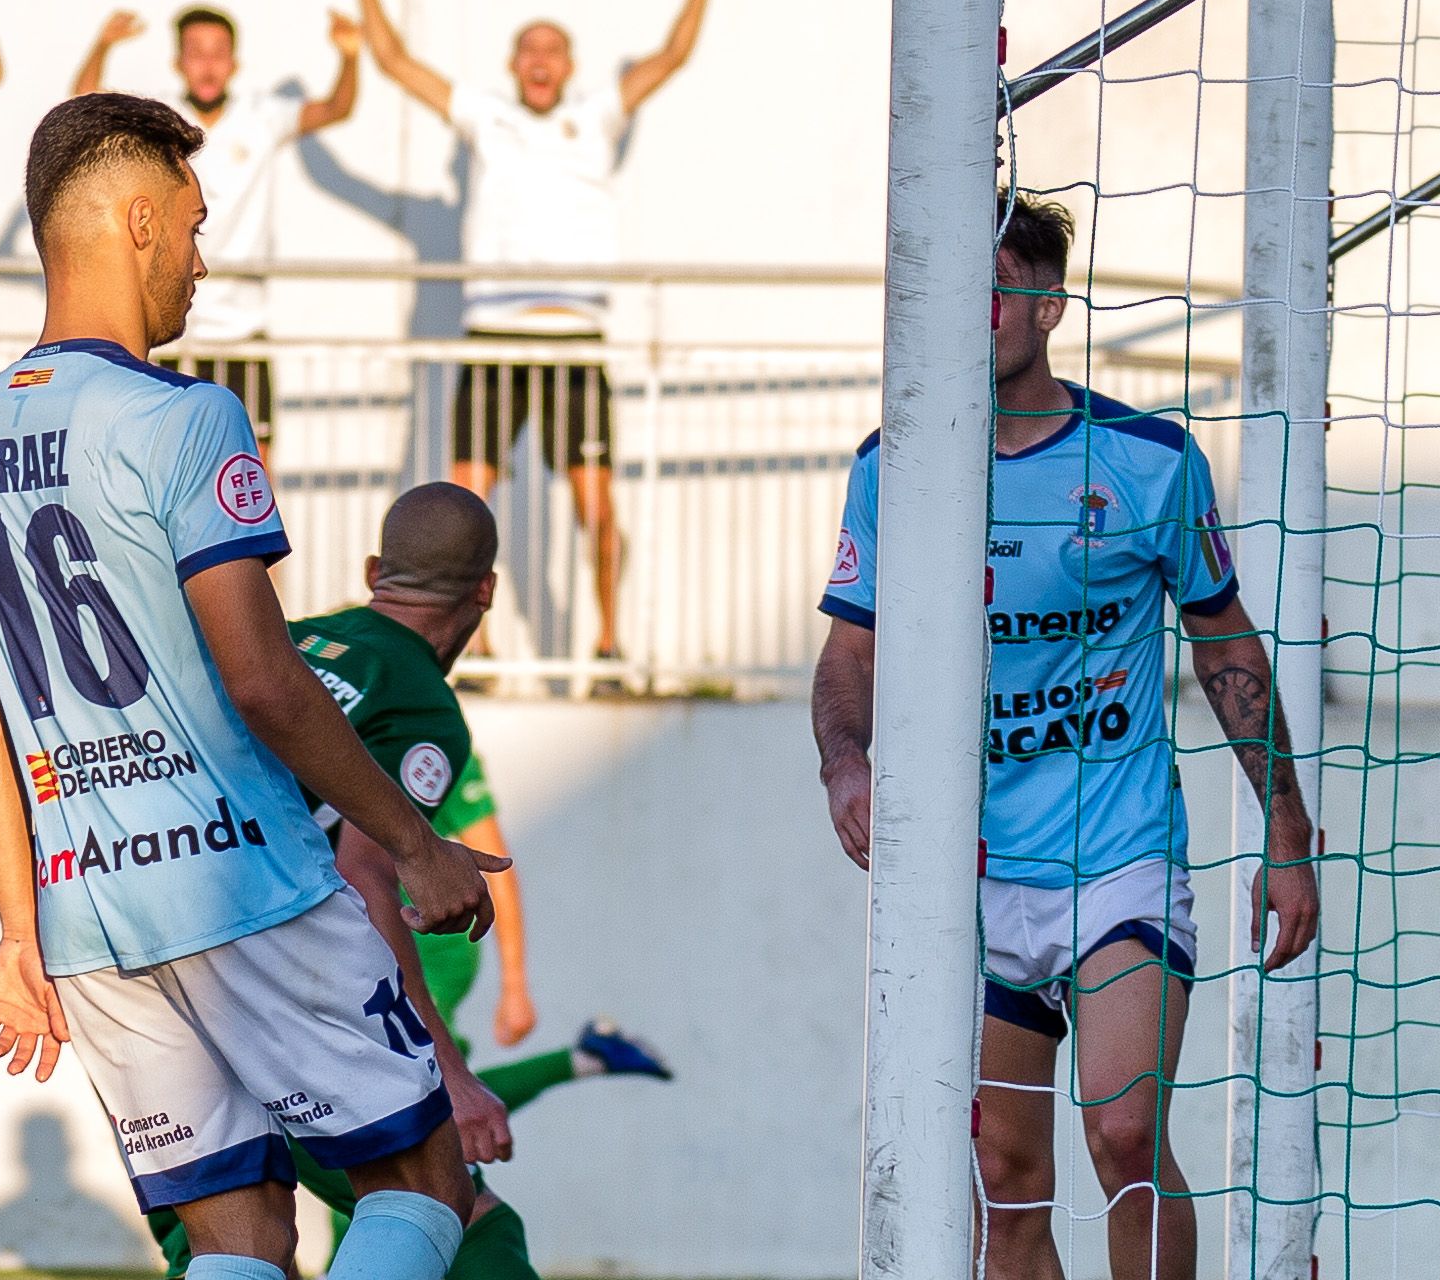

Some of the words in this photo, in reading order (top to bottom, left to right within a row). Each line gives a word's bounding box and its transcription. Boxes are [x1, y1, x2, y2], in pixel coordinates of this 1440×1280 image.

[230, 470, 258, 488] RF
[235, 489, 263, 508] EF
[988, 601, 1121, 644] arena
[992, 677, 1093, 719] LEJOS
[53, 729, 167, 770] GOBIERNO
[988, 701, 1131, 764] CAYO
[37, 796, 268, 888] omAranda
[262, 1091, 309, 1113] marca
[119, 1111, 170, 1135] Comarca
[145, 1123, 195, 1151] Aranda
